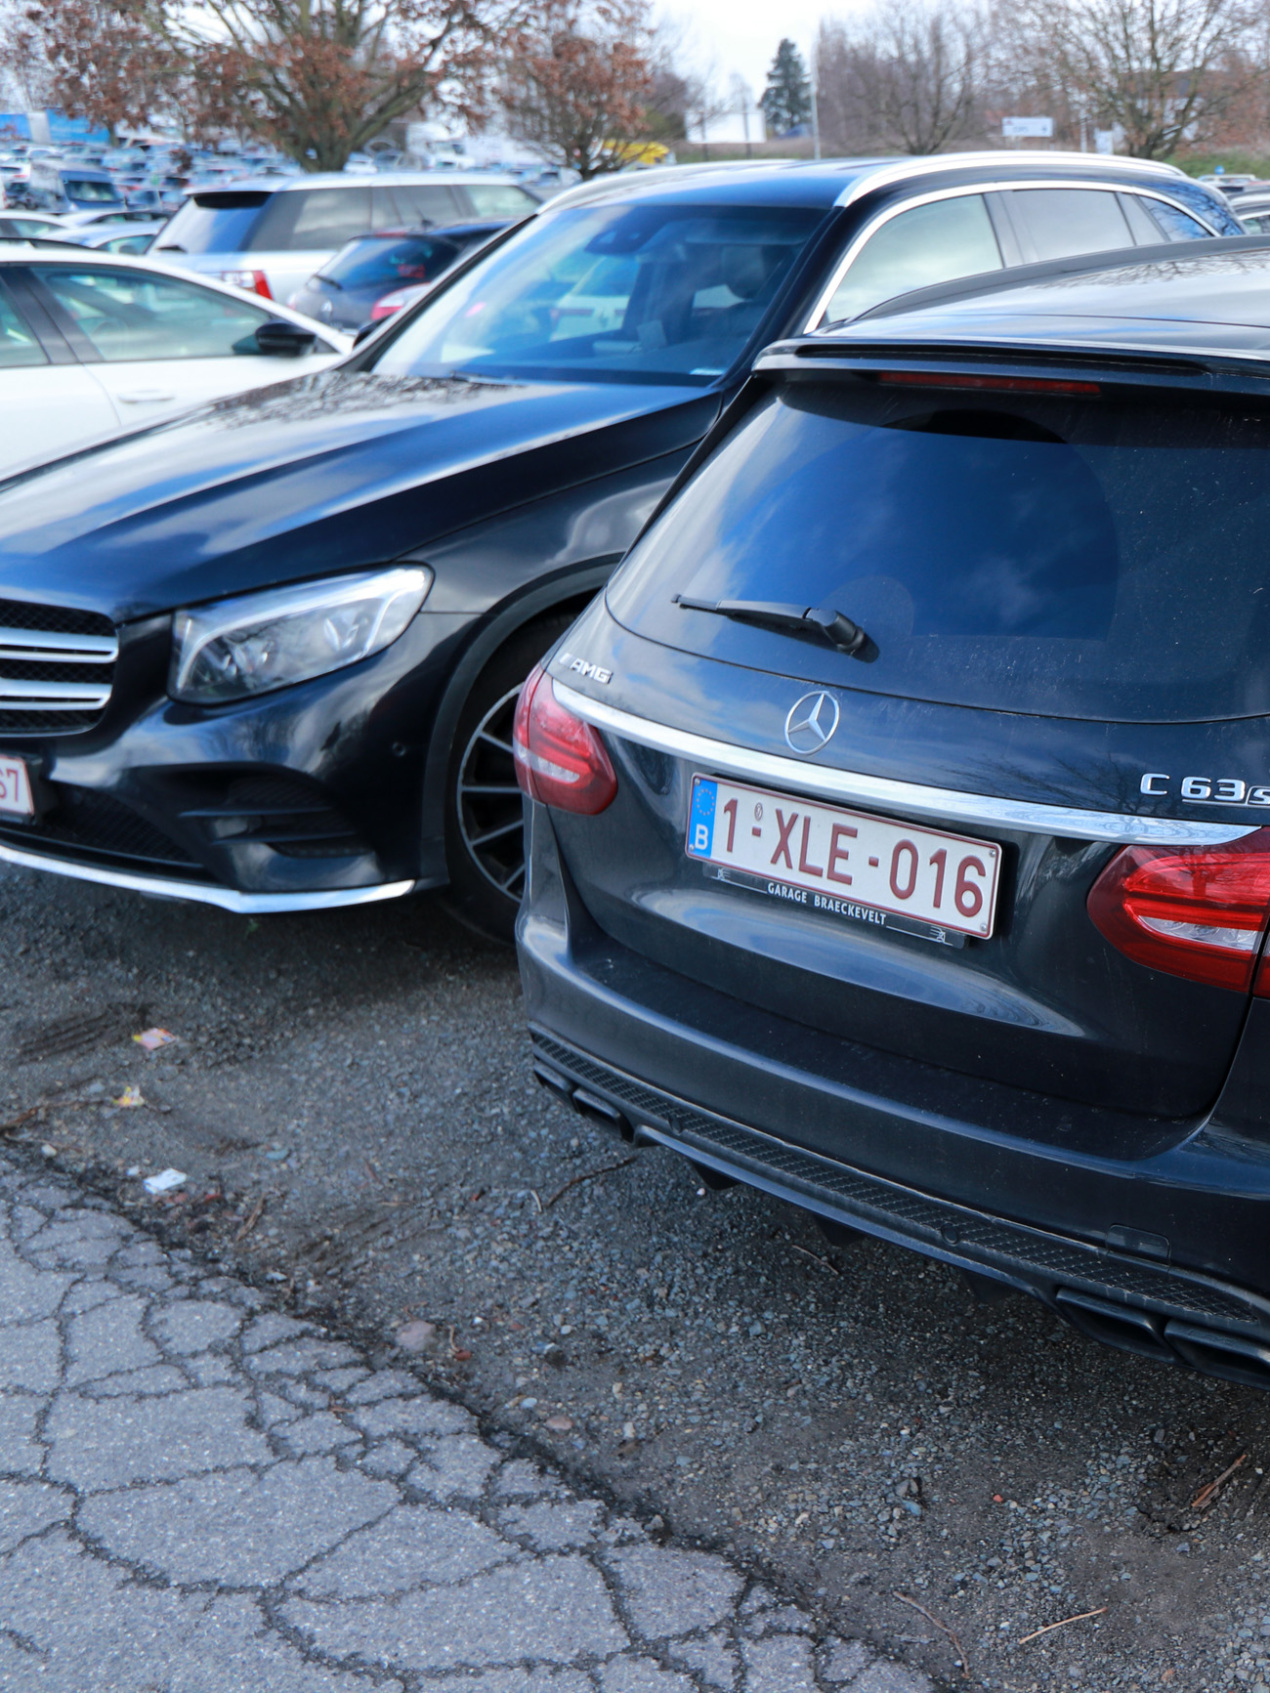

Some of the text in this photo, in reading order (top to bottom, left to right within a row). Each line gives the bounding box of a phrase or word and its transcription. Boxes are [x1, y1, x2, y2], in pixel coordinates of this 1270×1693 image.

[569, 658, 614, 685] AMG
[1140, 773, 1170, 796] C
[767, 882, 887, 926] GARAGE BRAECKEVELT
